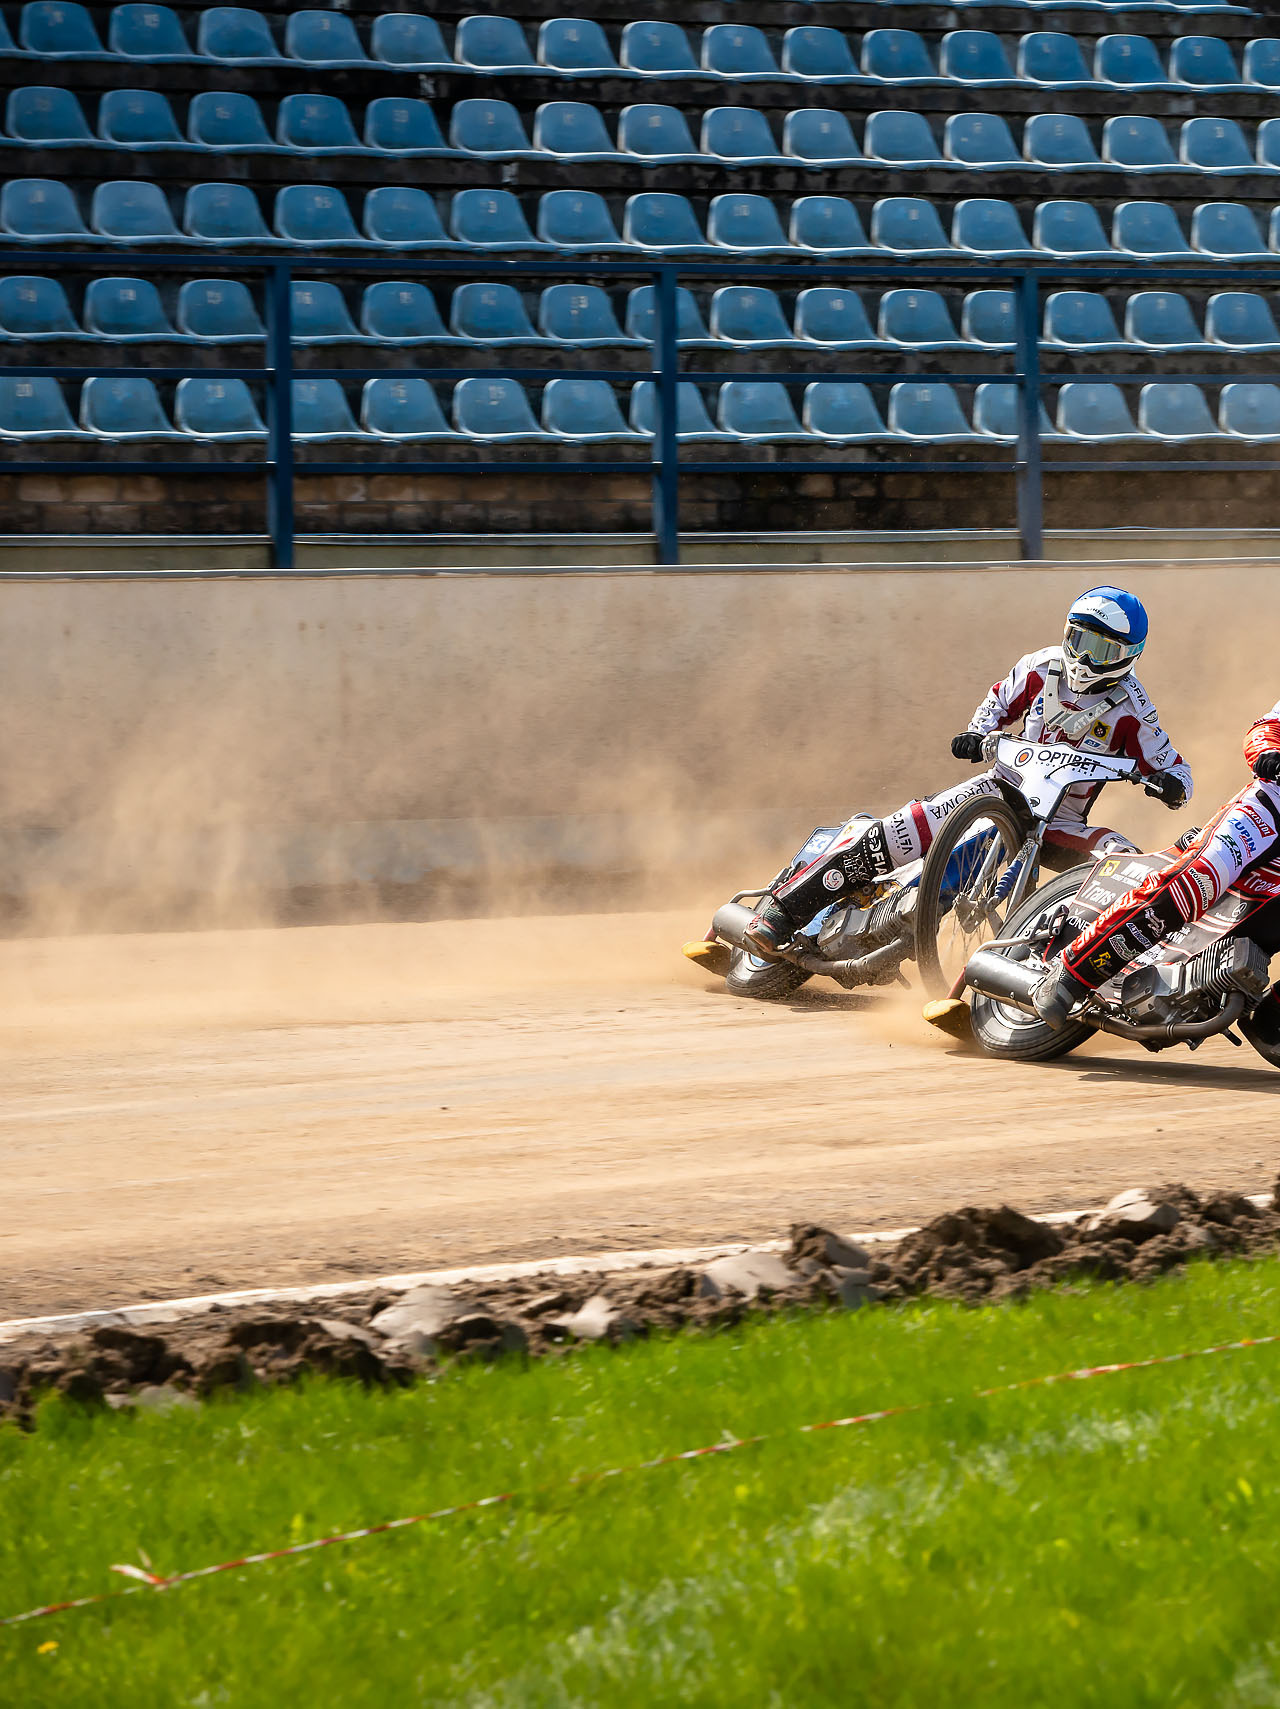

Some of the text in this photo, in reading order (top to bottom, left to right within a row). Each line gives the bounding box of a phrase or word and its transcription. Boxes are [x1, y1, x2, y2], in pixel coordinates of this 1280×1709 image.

[1072, 702, 1109, 732] ATLAS
[1038, 750, 1100, 772] OPTIBET
[1228, 817, 1257, 852] ZUPIN
[1080, 880, 1117, 906] Trans
